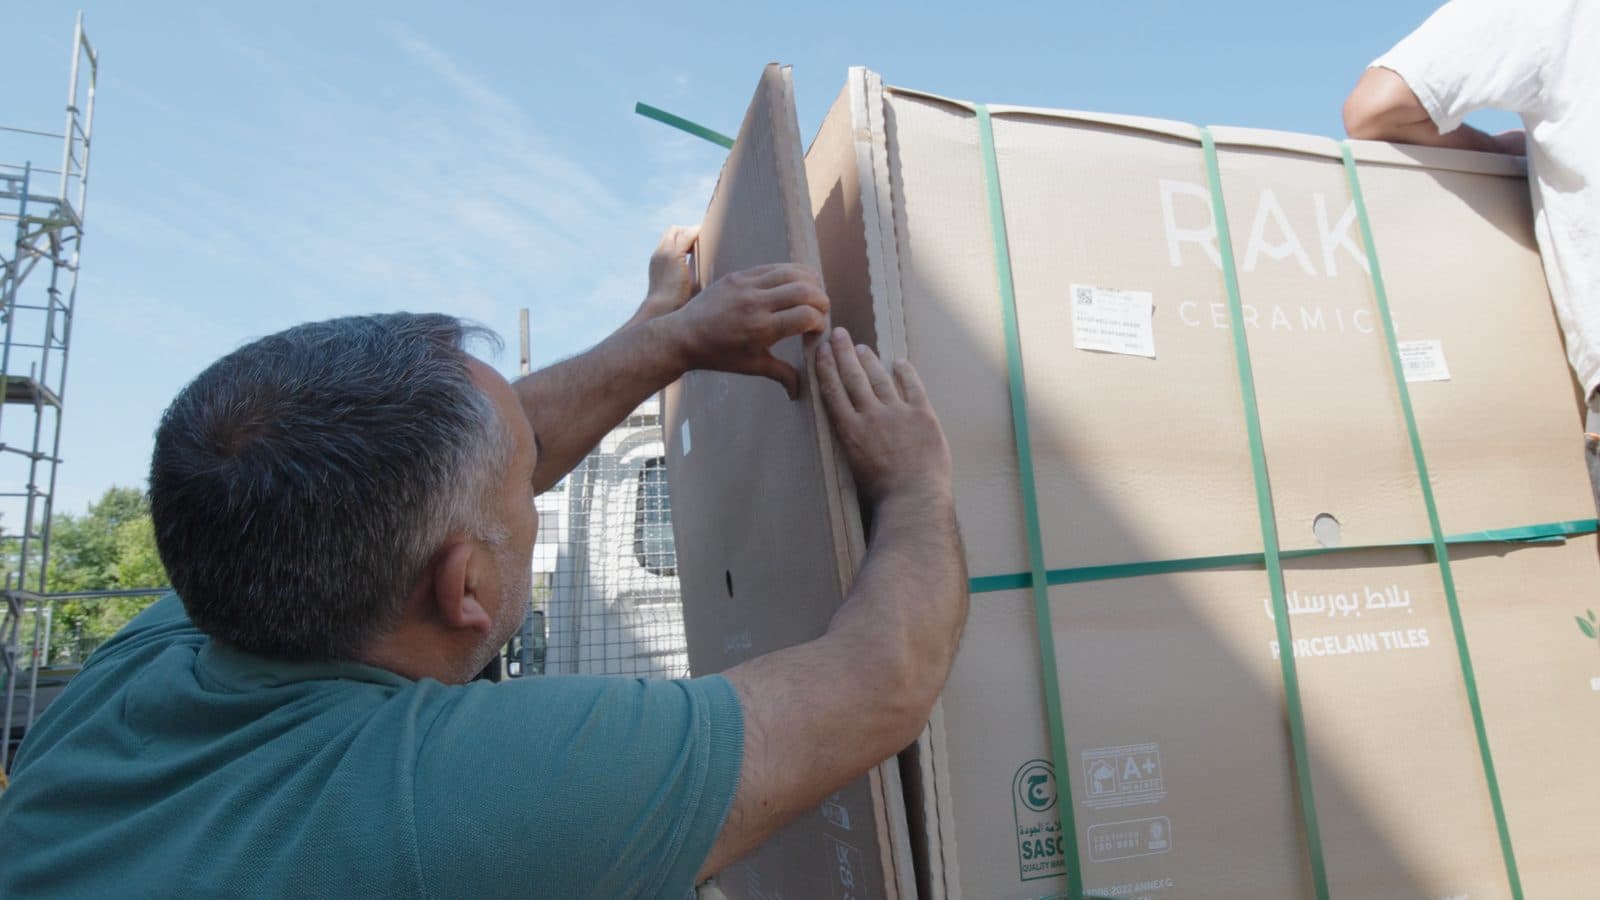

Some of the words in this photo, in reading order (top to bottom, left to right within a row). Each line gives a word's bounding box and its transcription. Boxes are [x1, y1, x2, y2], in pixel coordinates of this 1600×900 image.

[1159, 178, 1372, 278] RAK
[1179, 299, 1398, 335] CERAMIC
[1364, 583, 1413, 614] بلاط
[1379, 628, 1430, 650] TILES
[1123, 756, 1156, 780] A+
[1023, 861, 1050, 872] QUALITY
